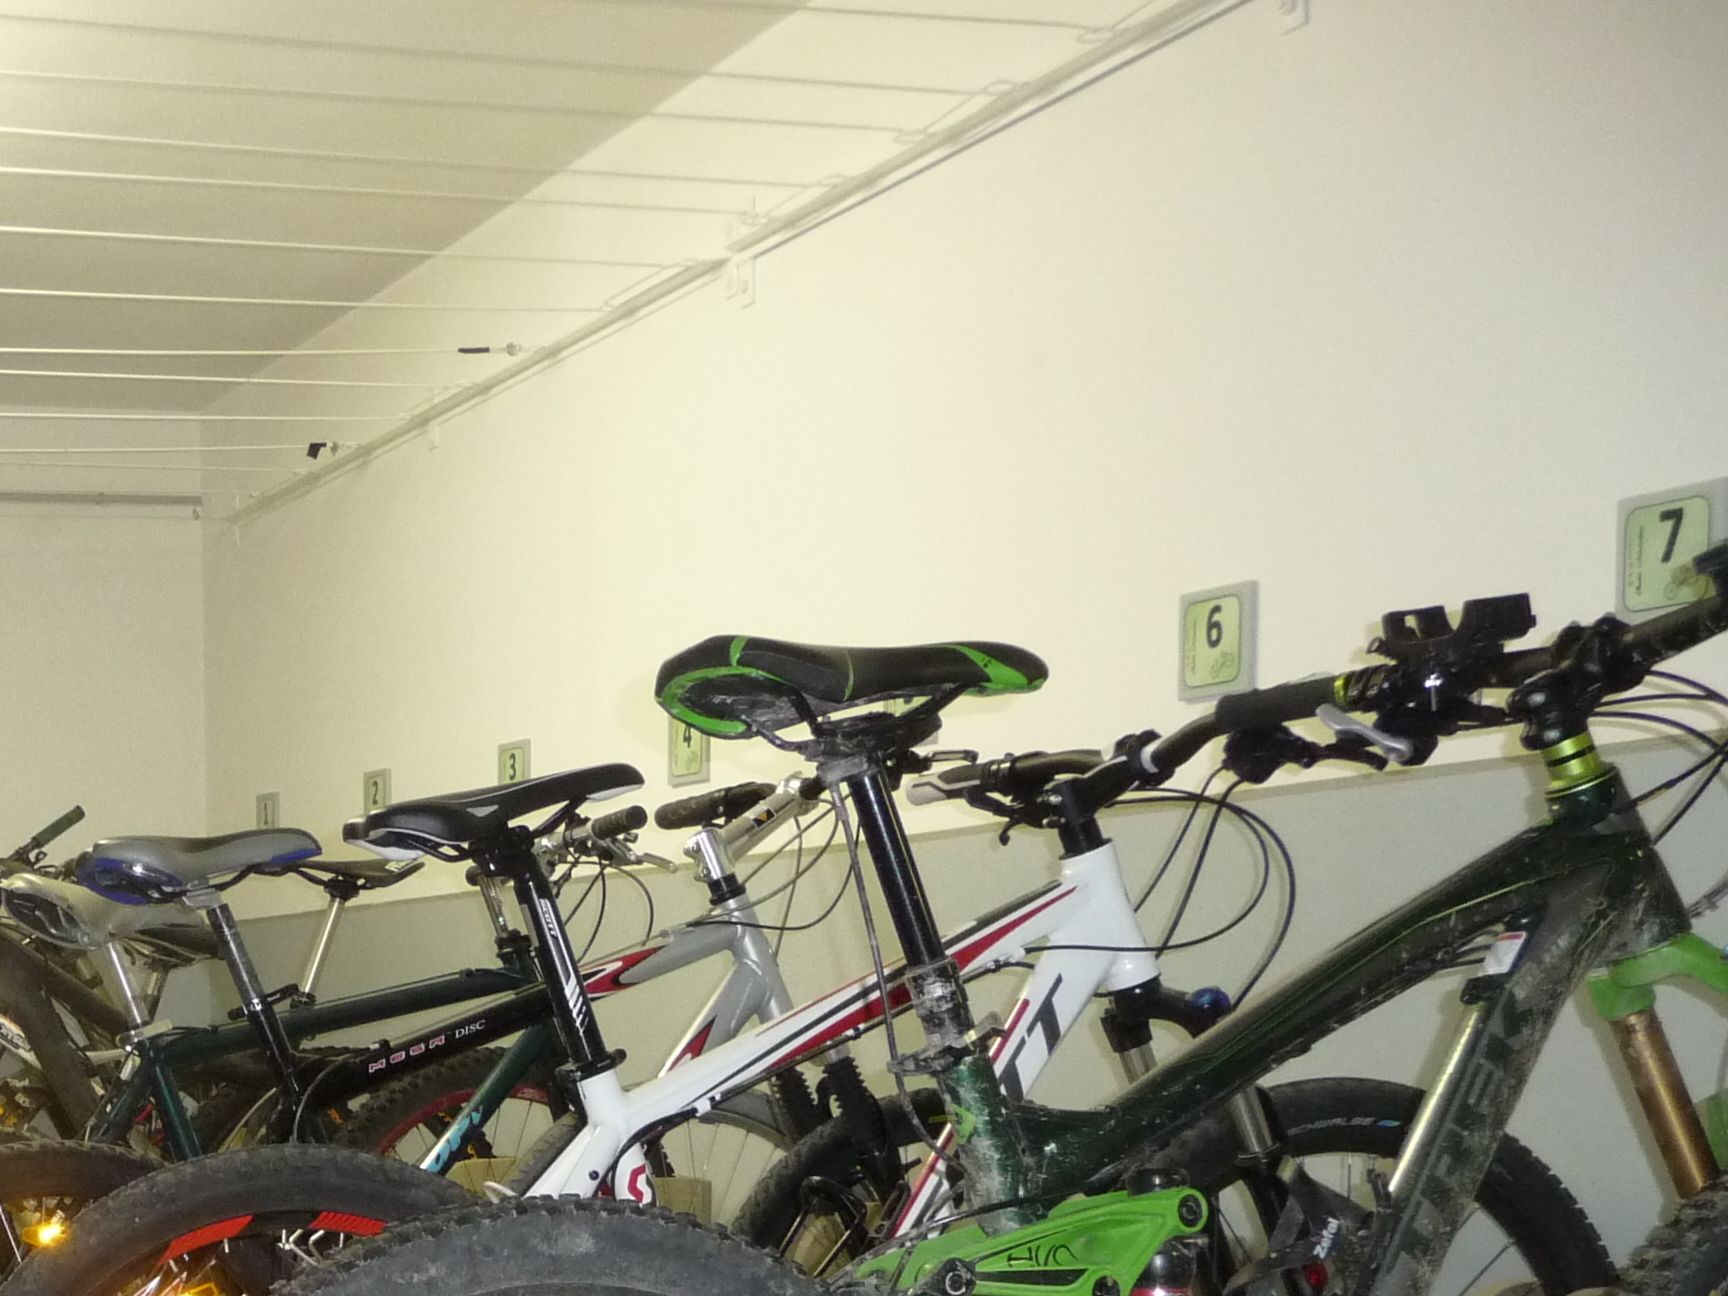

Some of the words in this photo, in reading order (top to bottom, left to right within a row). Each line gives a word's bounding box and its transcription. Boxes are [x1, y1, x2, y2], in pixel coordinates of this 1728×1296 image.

[1659, 507, 1684, 563] 7
[1204, 604, 1223, 649] 6
[682, 721, 693, 749] 4
[507, 752, 518, 781] 3
[371, 780, 379, 806] 2
[262, 802, 269, 826] 1
[454, 1018, 488, 1040] DISC
